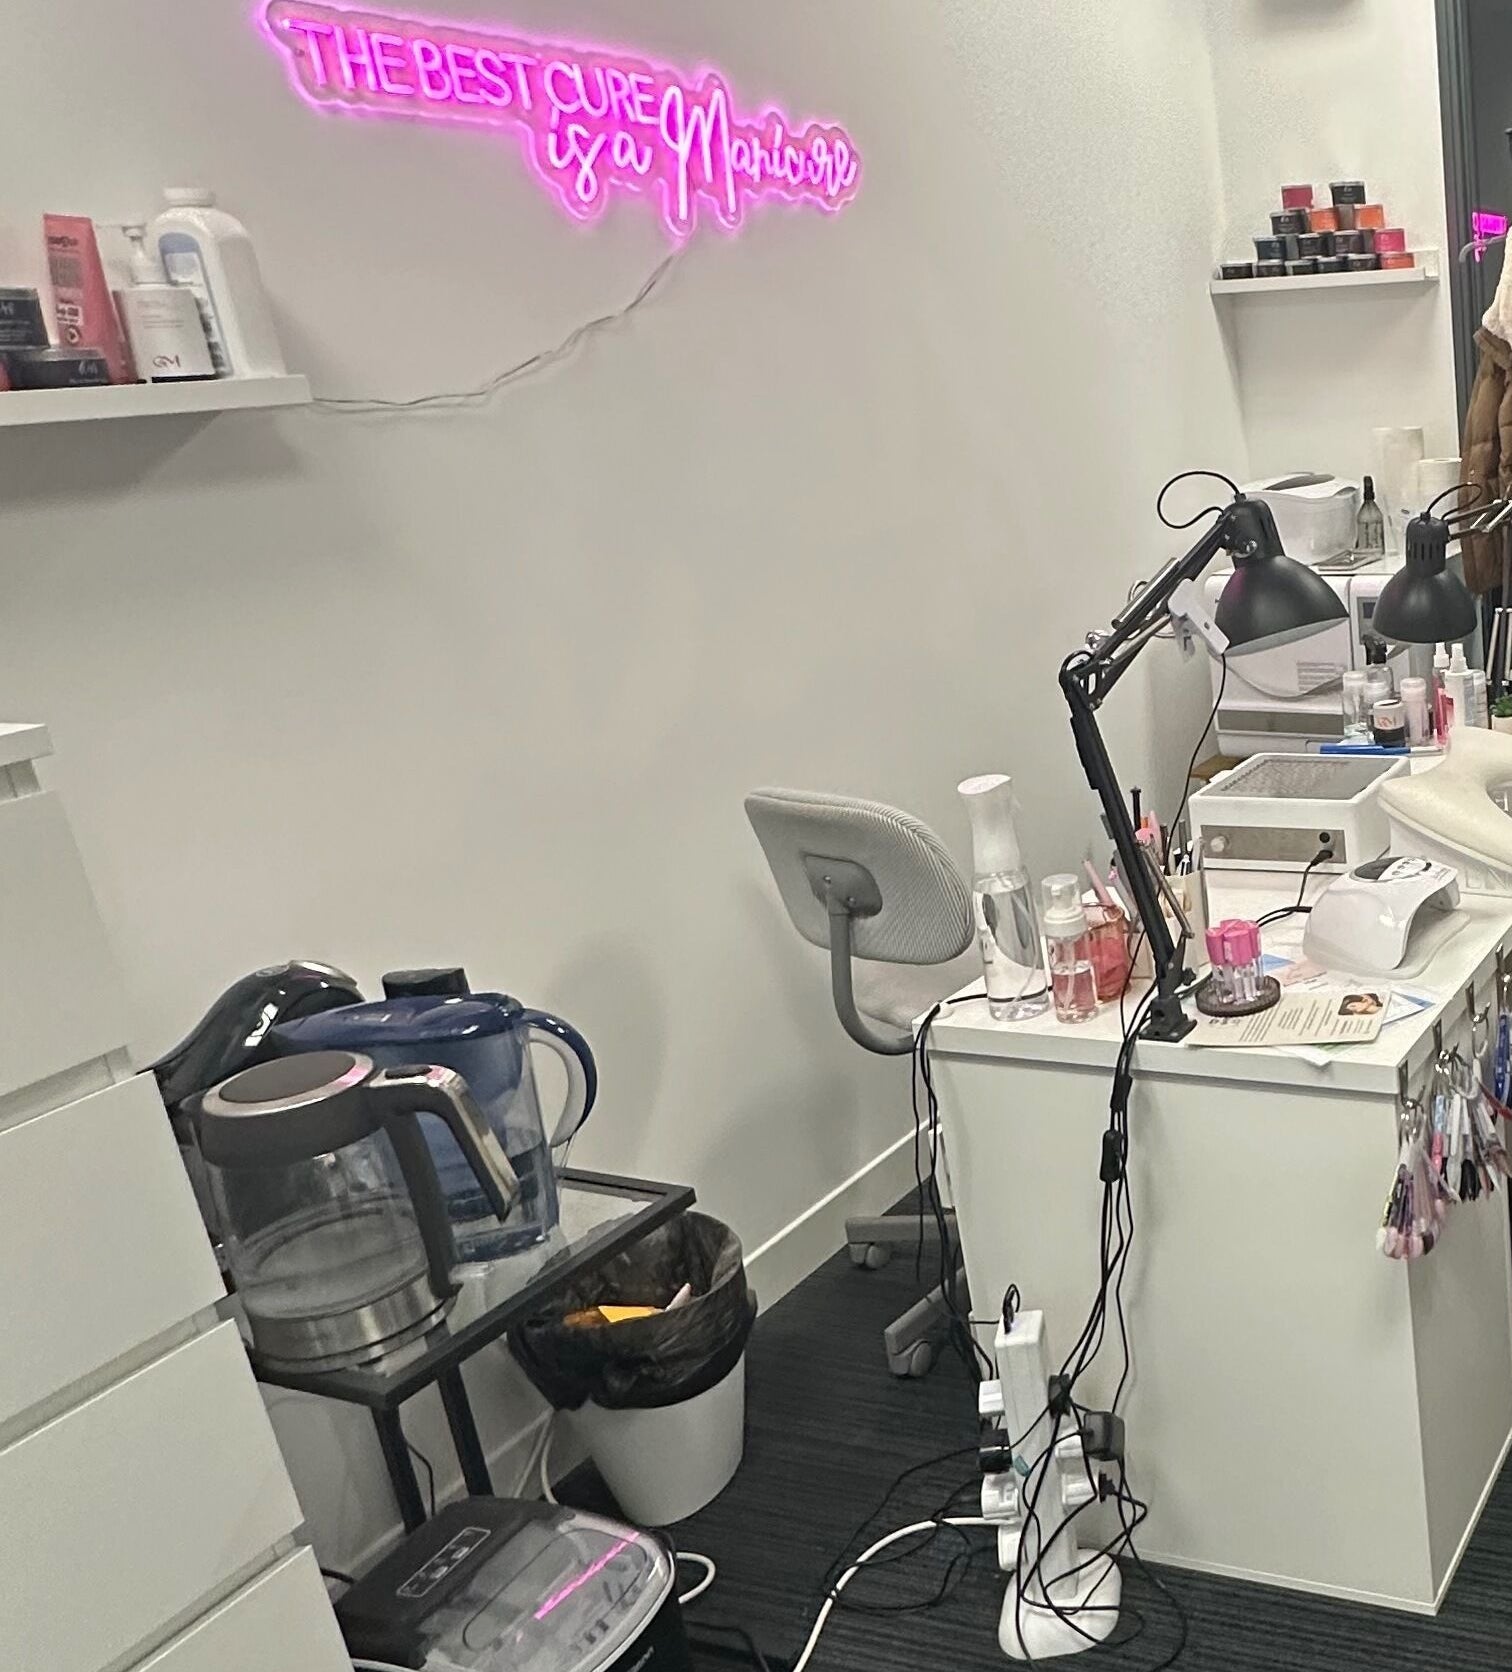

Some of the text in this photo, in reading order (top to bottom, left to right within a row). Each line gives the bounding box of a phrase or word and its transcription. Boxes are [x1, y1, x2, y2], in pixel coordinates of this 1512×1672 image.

[286, 18, 659, 125] THE BEST CURE
[548, 84, 857, 221] is a Manicure
